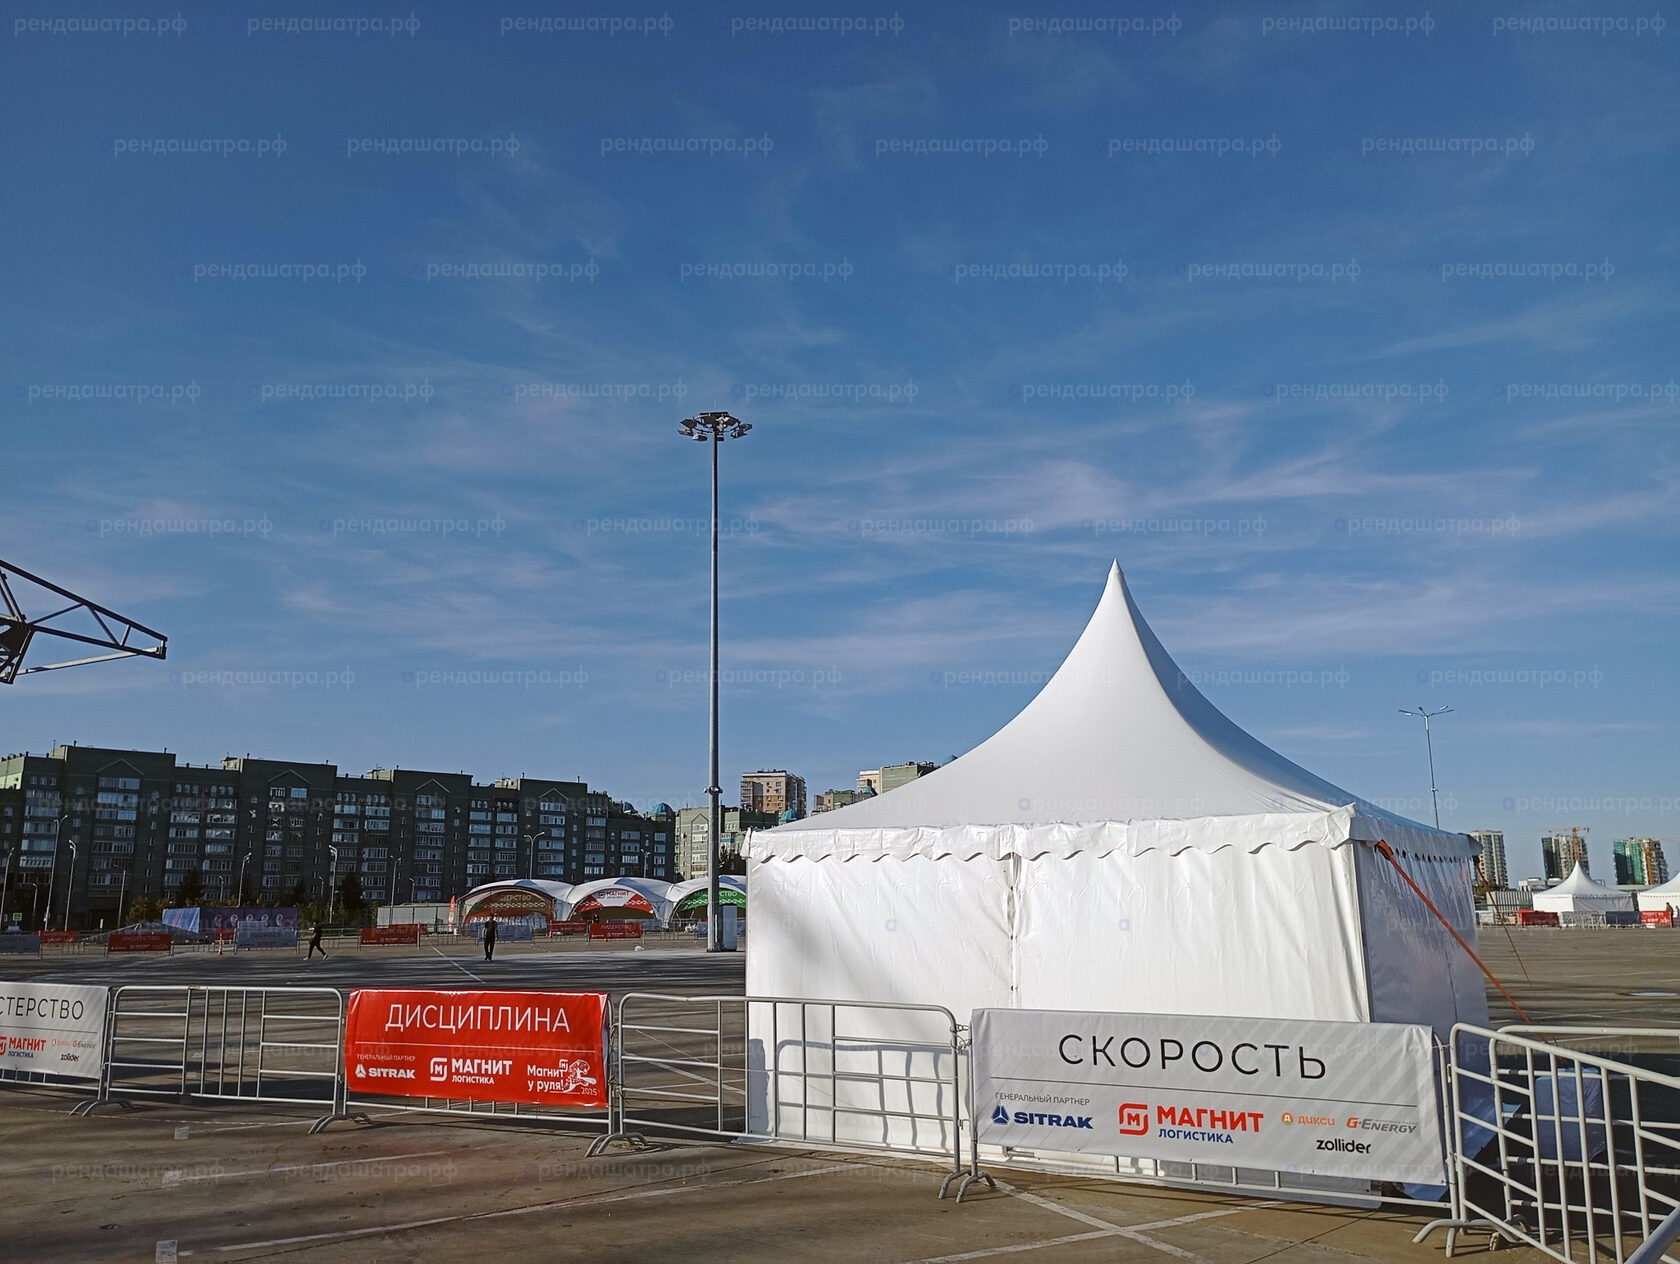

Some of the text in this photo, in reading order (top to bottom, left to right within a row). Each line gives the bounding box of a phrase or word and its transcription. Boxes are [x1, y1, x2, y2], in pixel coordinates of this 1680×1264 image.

[385, 1004, 570, 1034] ДИСЦИПЛИНА
[9, 1037, 46, 1051] МАГНИТ
[1058, 1033, 1327, 1080] СКОРОСТЬ
[368, 1068, 416, 1079] SITRAK
[451, 1058, 513, 1075] МАГНИТ
[527, 1065, 565, 1077] Магнит
[451, 1075, 495, 1084] ЛОГИСТИКА
[528, 1080, 564, 1092] у руля!
[995, 1092, 1090, 1106] ГЕНЕРАЛЬНЫЙ ПАРТНЕР
[1014, 1111, 1094, 1129] SITRAK
[1156, 1105, 1264, 1132] МАГНИТ
[1158, 1128, 1234, 1144] ЛОГИСТИКА
[1316, 1138, 1372, 1154] zollider
